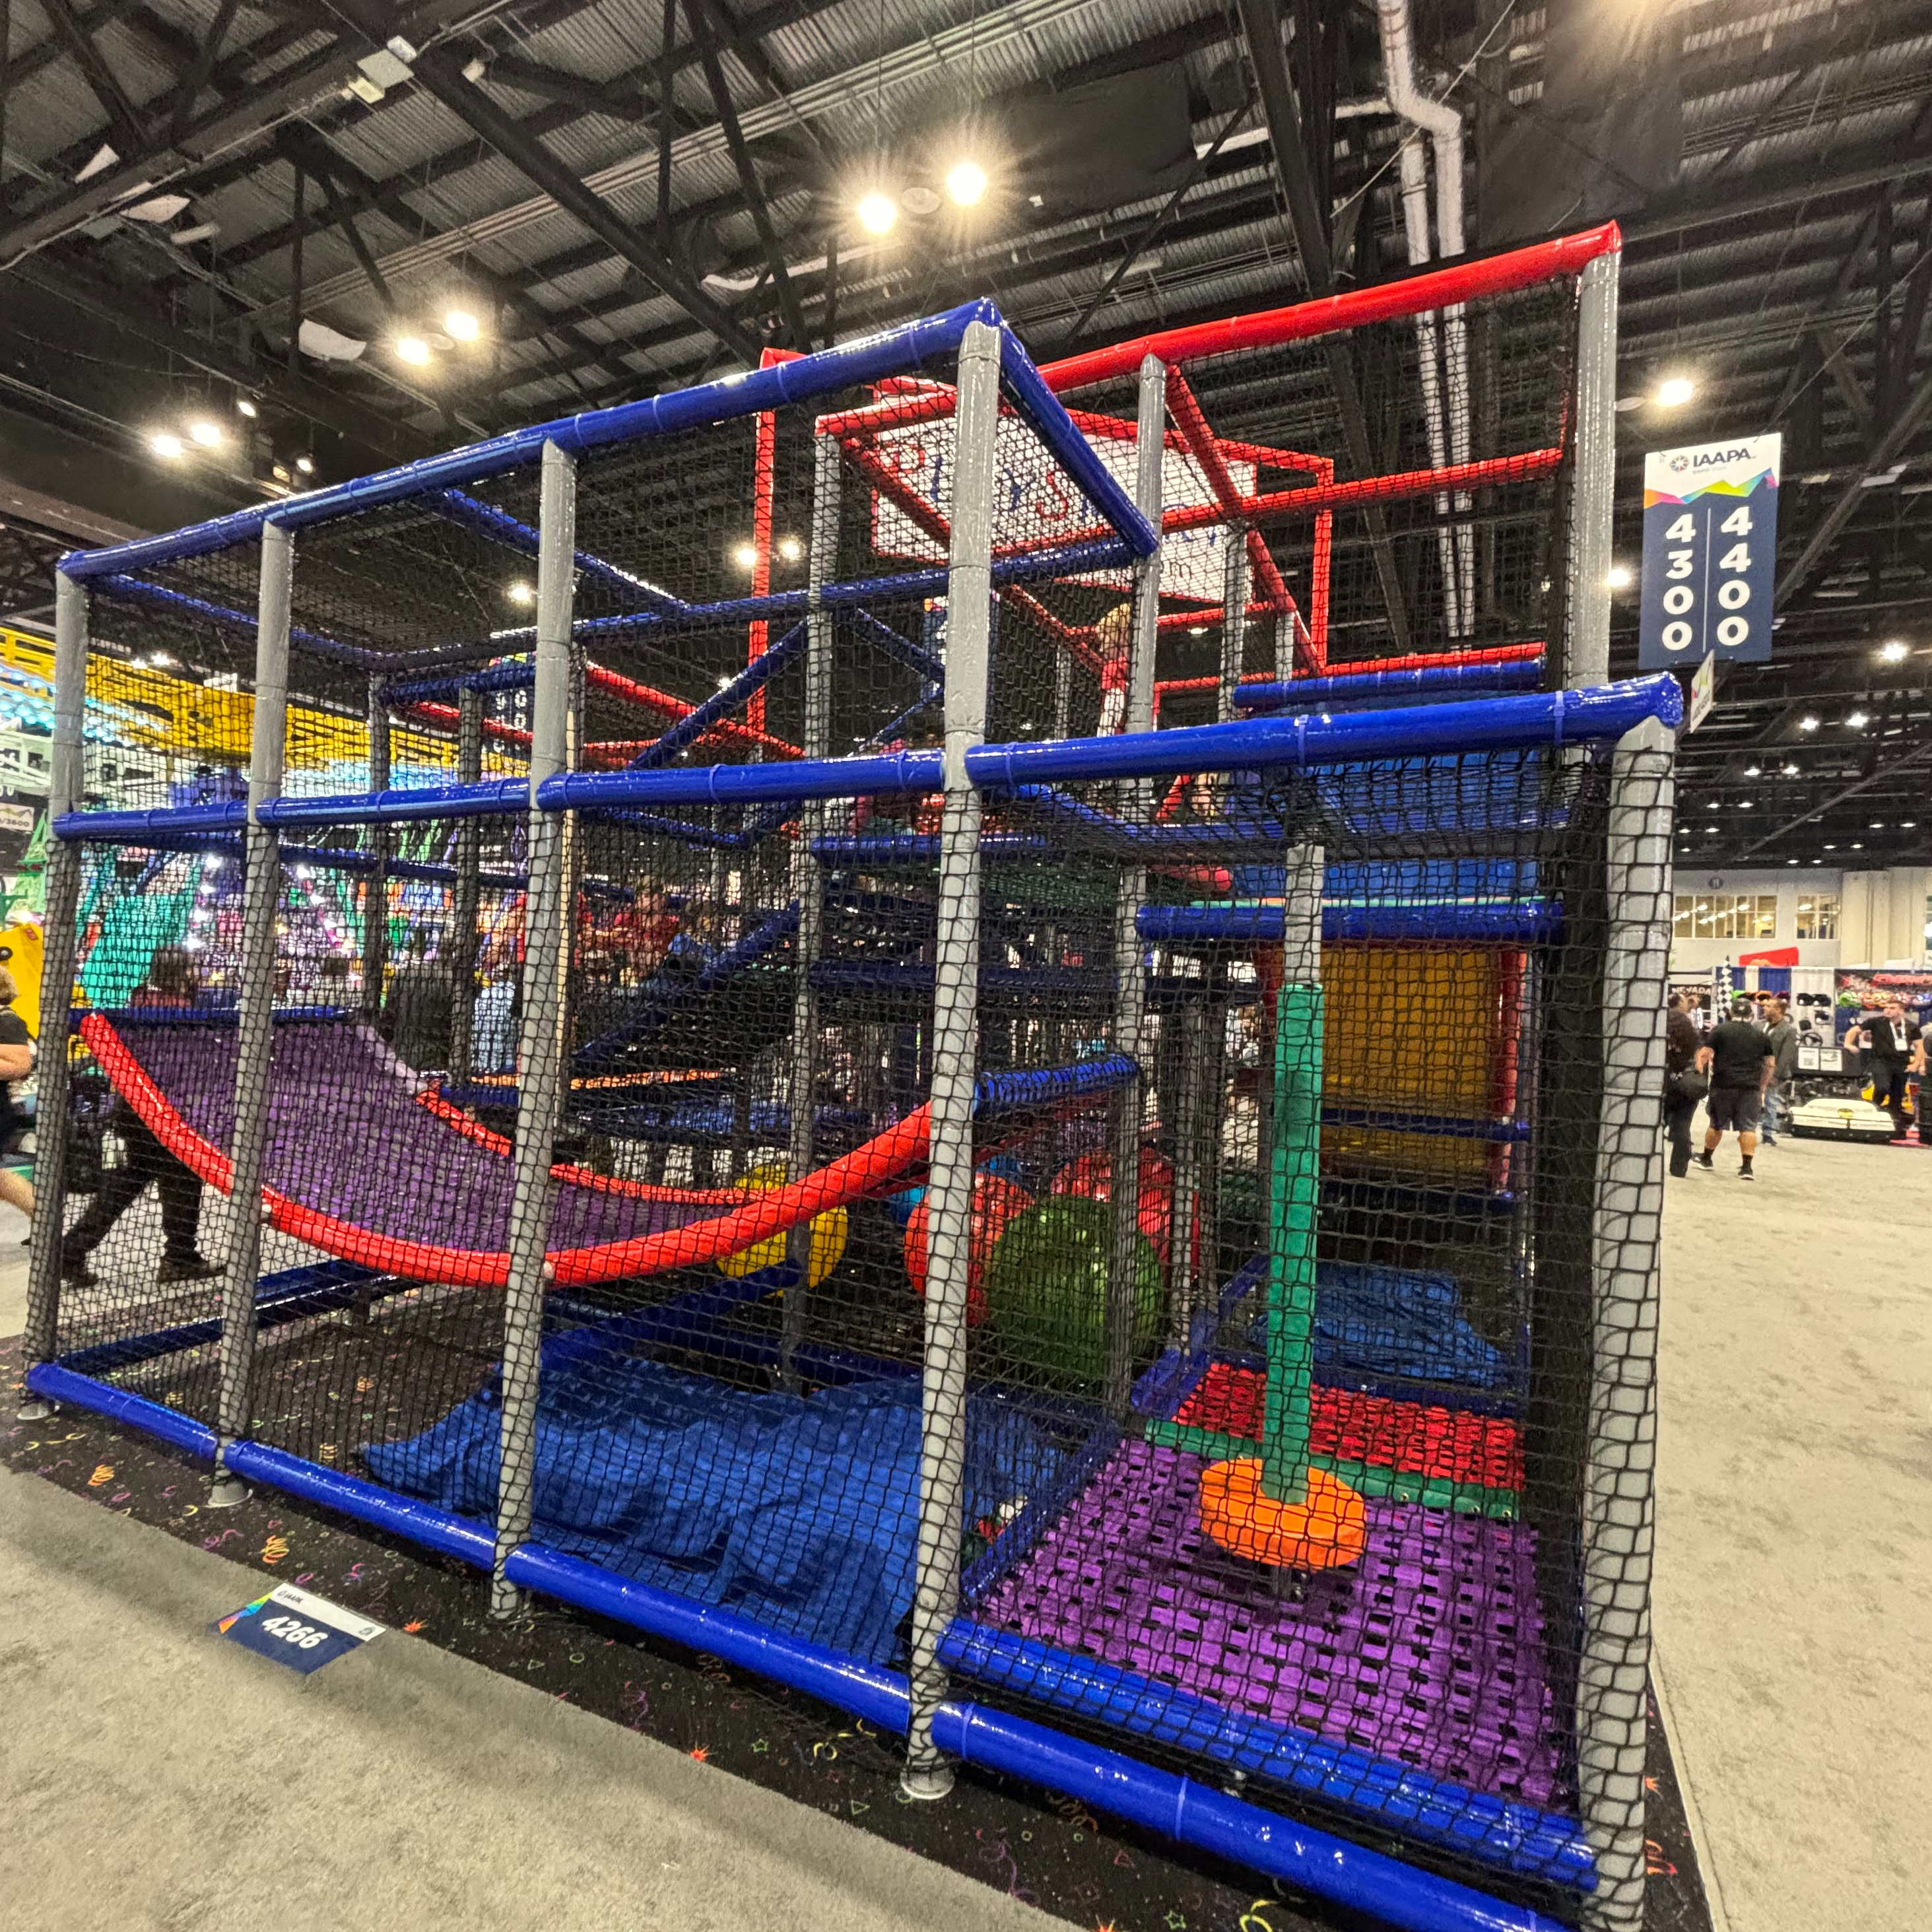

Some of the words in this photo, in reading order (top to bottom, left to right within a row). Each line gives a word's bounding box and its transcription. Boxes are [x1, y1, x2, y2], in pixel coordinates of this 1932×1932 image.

[1693, 448, 1751, 467] IAAPA
[1661, 513, 1696, 650] 4300
[1716, 506, 1752, 646] 4400
[261, 1616, 328, 1649] 4266
